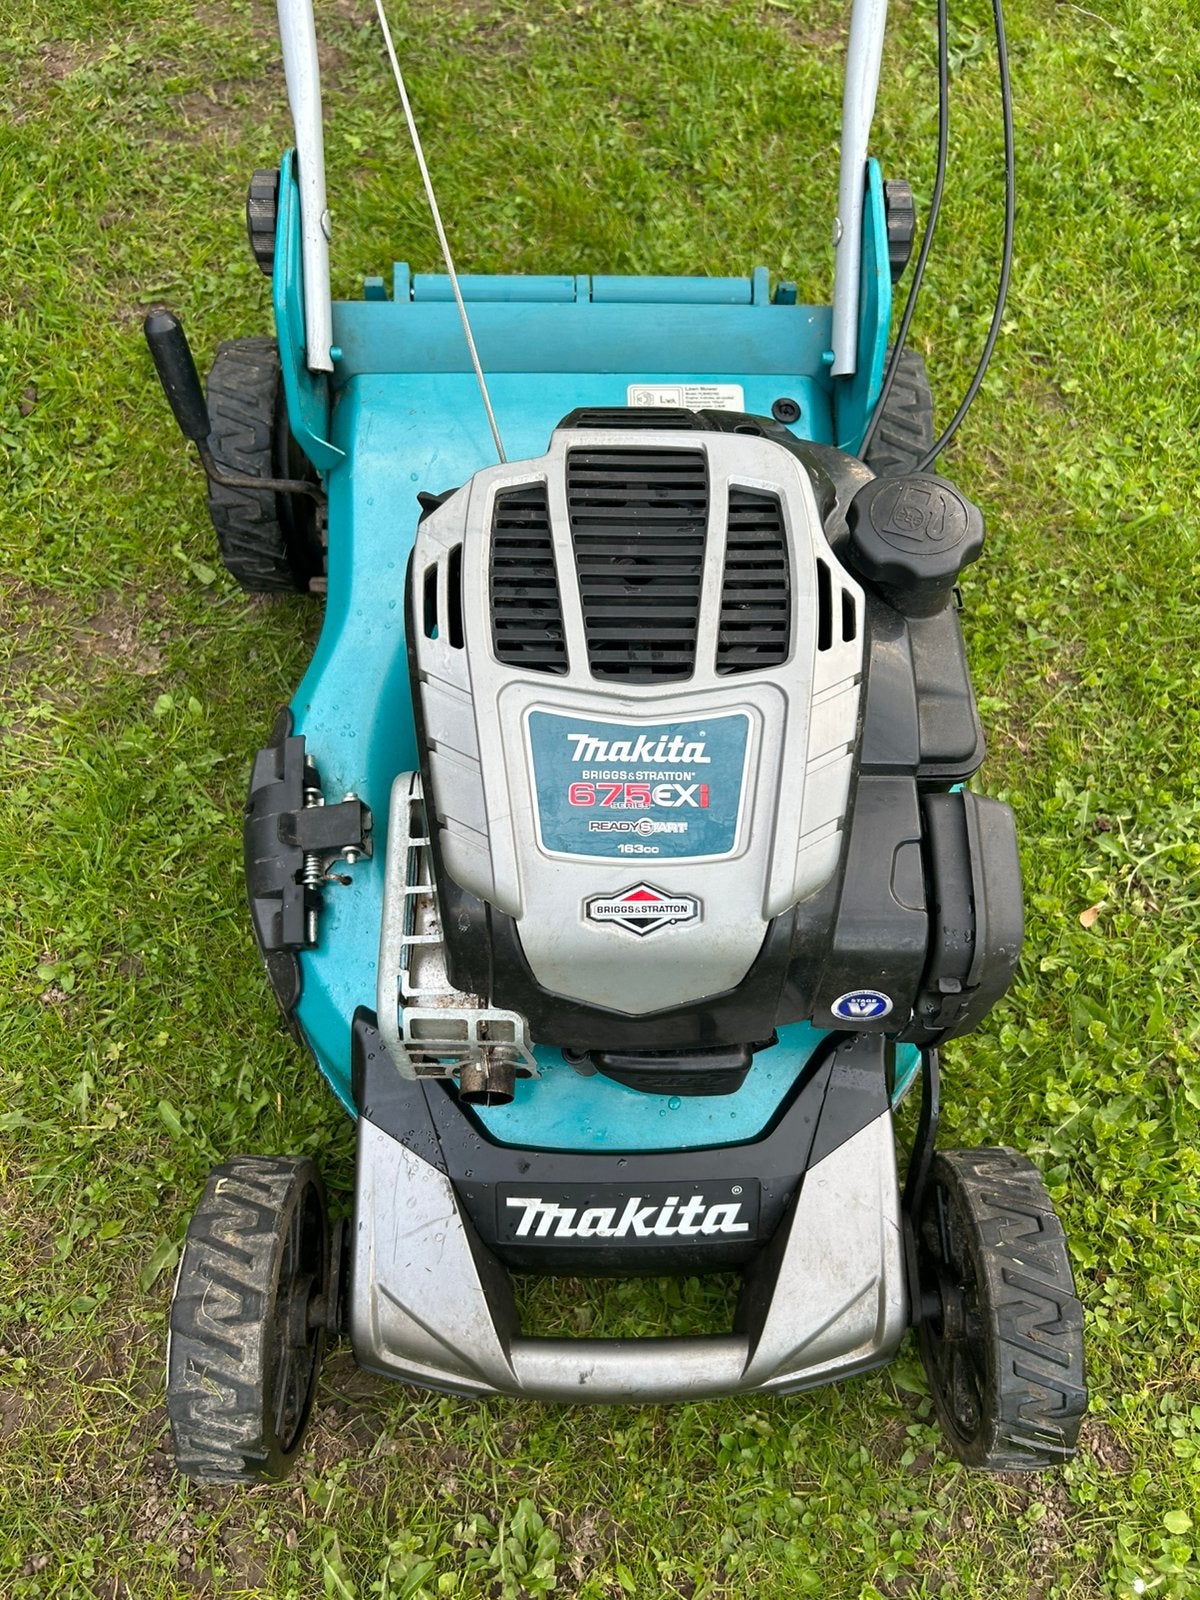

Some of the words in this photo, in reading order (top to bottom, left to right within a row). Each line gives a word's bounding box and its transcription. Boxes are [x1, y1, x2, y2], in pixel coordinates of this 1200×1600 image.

[567, 733, 711, 763] Makita
[610, 802, 651, 810] SERIES
[618, 844, 660, 854] 163cc
[597, 905, 688, 914] BRIGGS&STRATTON
[506, 1195, 749, 1237] Makita
